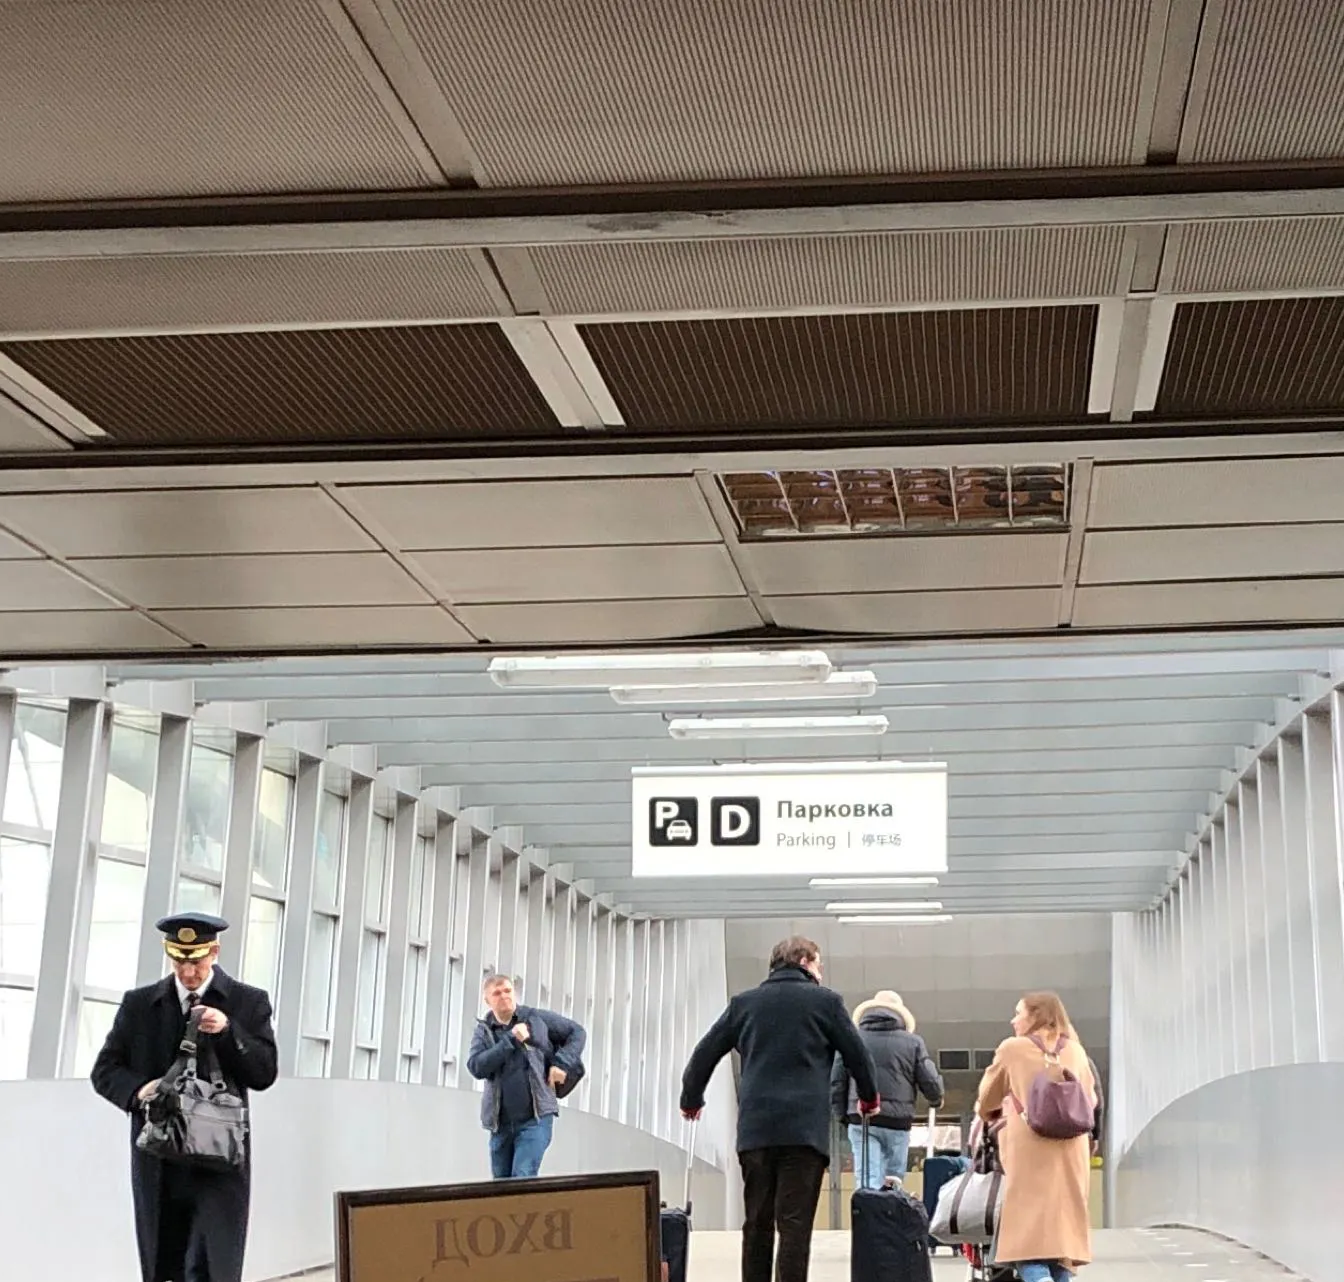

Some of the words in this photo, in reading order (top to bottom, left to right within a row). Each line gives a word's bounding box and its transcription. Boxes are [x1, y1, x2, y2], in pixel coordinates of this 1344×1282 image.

[655, 801, 679, 829] P
[720, 804, 751, 838] D
[777, 800, 893, 823] Парковка
[776, 832, 836, 850] Parking
